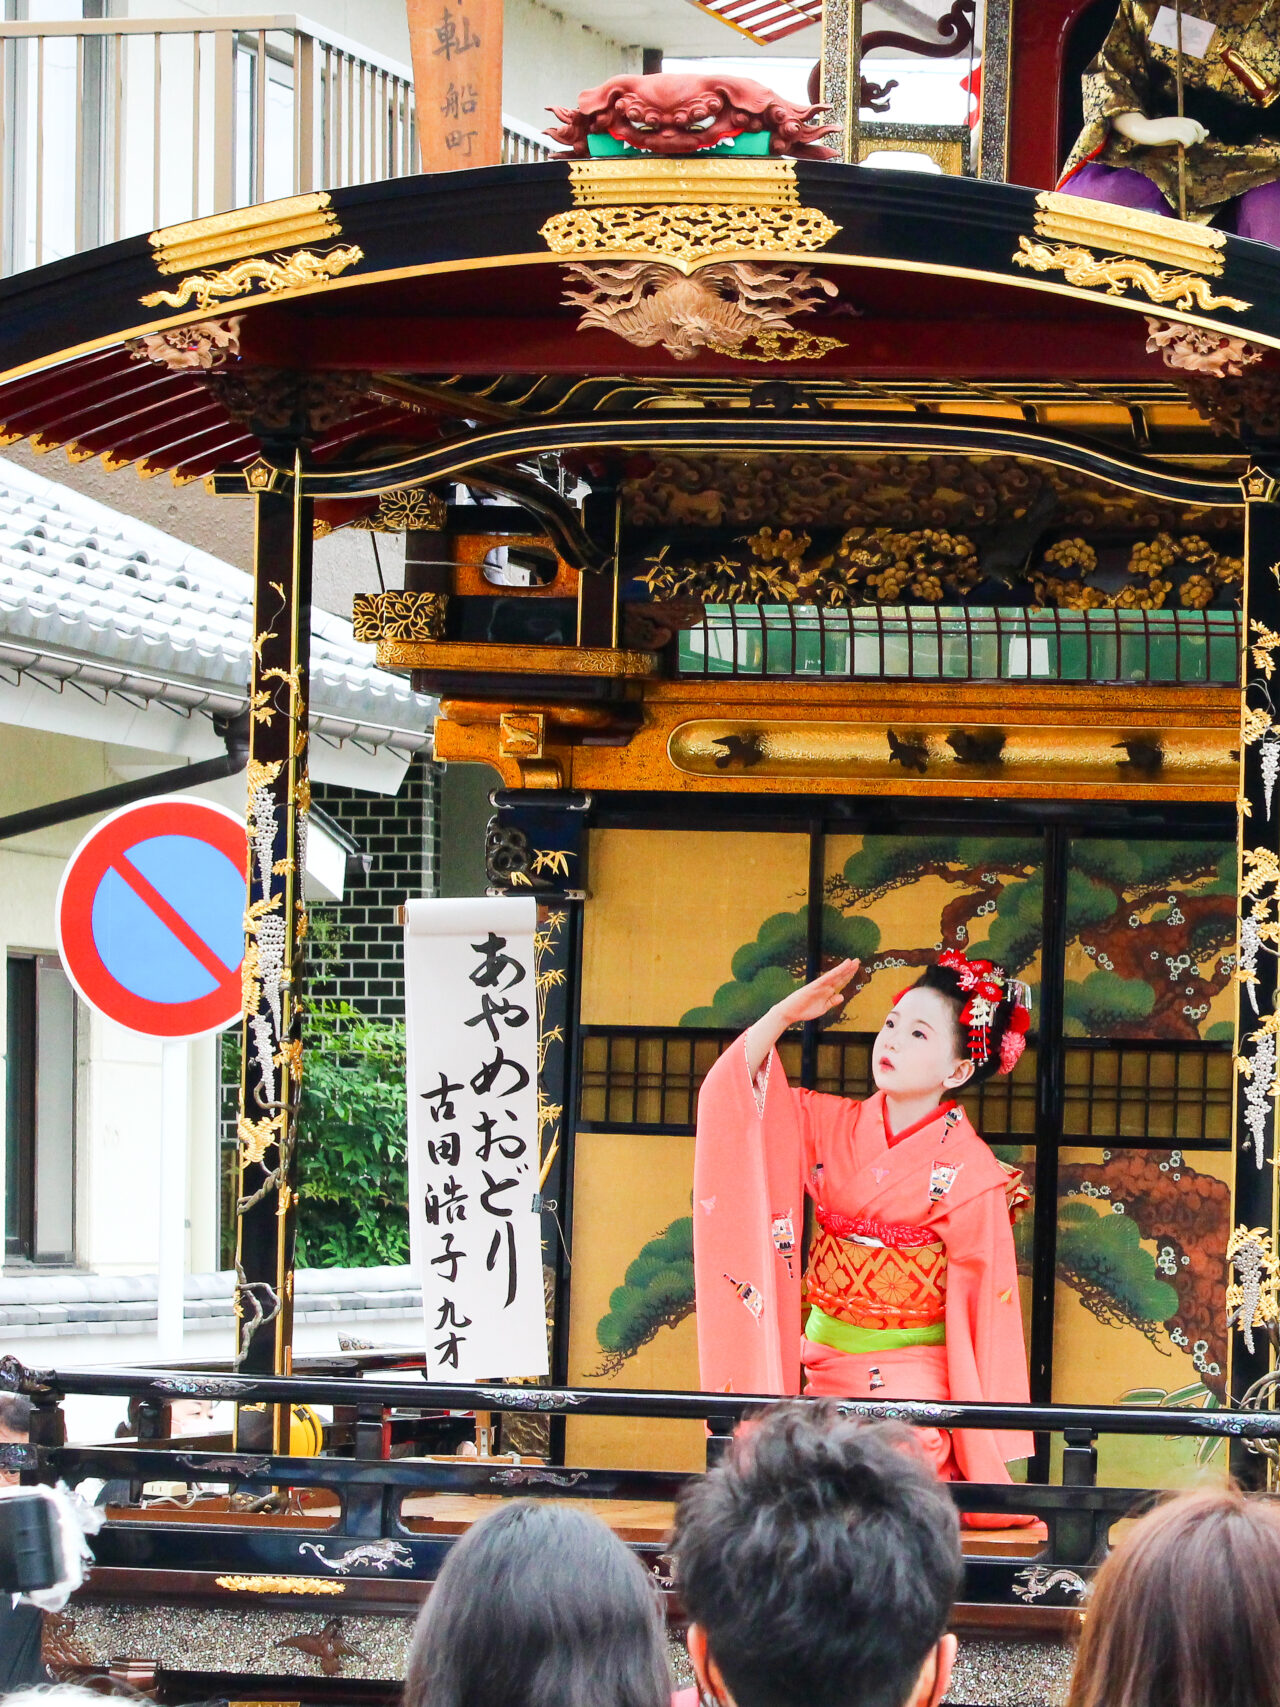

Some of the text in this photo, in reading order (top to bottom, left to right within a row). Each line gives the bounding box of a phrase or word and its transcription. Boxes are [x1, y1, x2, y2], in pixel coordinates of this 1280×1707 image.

[464, 932, 530, 1309] あやめおどり
